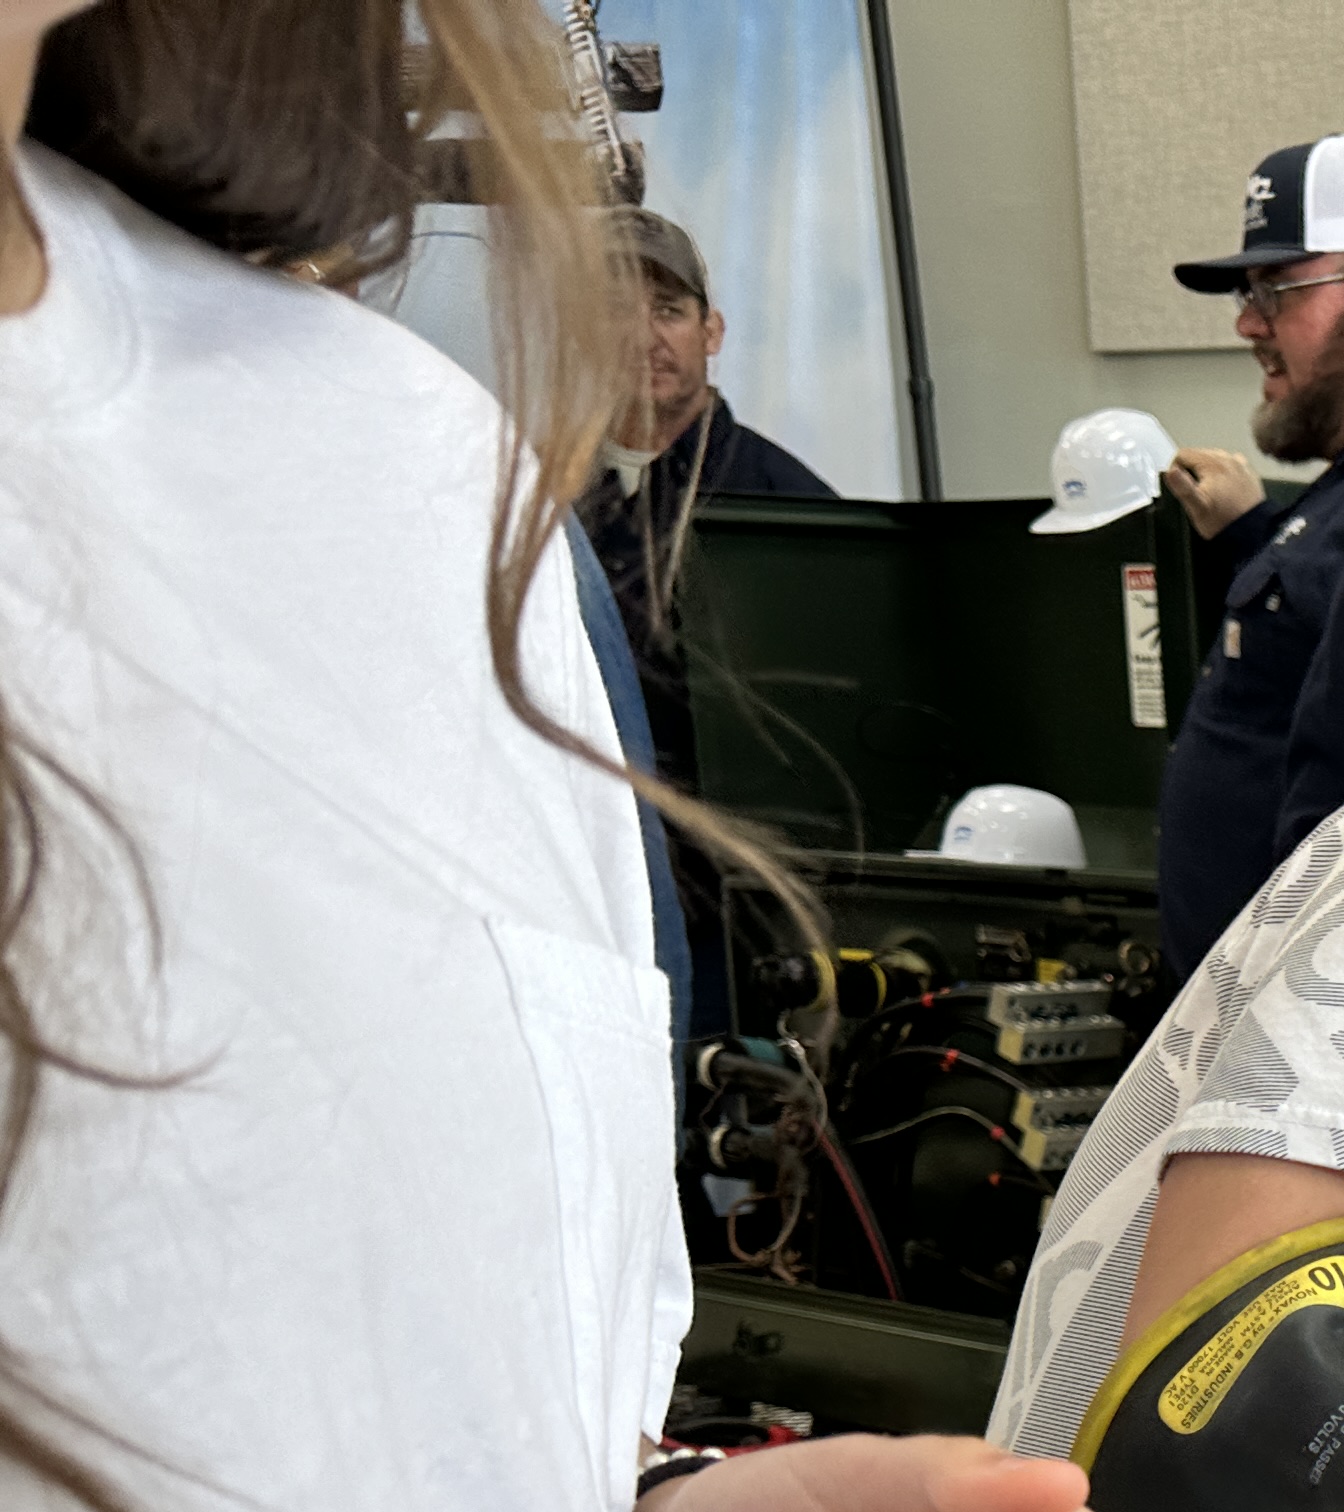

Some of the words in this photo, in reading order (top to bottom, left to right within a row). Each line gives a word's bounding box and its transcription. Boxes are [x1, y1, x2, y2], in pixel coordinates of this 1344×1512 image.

[1273, 1287, 1318, 1316] NOVAX
[1216, 1319, 1241, 1345] VOLT
[1240, 1308, 1266, 1338] ASTM
[1252, 1323, 1266, 1338] by
[1187, 1346, 1212, 1375] 17000
[1206, 1366, 1216, 1377] IN
[1164, 1383, 1178, 1399] AC
[1174, 1377, 1196, 1402] TYPE
[1179, 1374, 1188, 1384] V
[1176, 1383, 1200, 1412] D120
[1180, 1362, 1233, 1429] INDUSTRIES
[1308, 1414, 1343, 1454] VOLTS
[1309, 1437, 1341, 1485] PASSED
